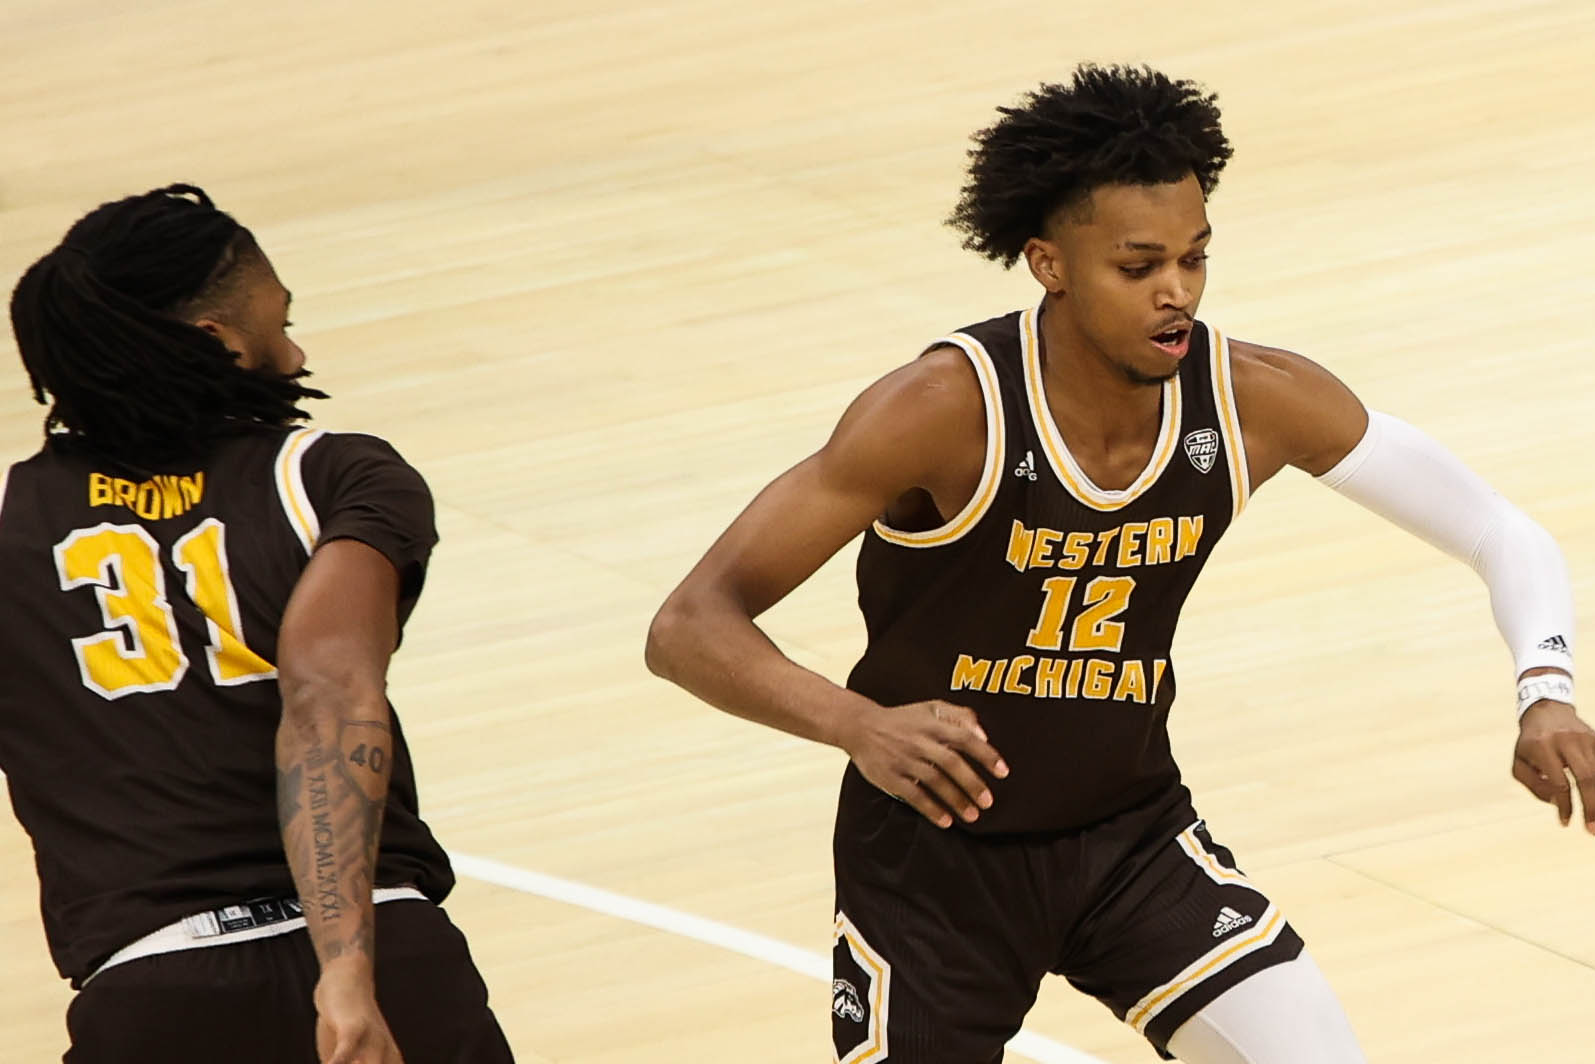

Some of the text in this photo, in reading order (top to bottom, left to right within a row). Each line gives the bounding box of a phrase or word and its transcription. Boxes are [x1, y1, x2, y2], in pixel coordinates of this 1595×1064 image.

[89, 471, 204, 520] BROWN
[1005, 515, 1204, 572] WESTERN
[53, 517, 279, 700] 31
[1025, 575, 1136, 653] 12
[349, 743, 384, 774] 40
[1212, 914, 1253, 938] adidas
